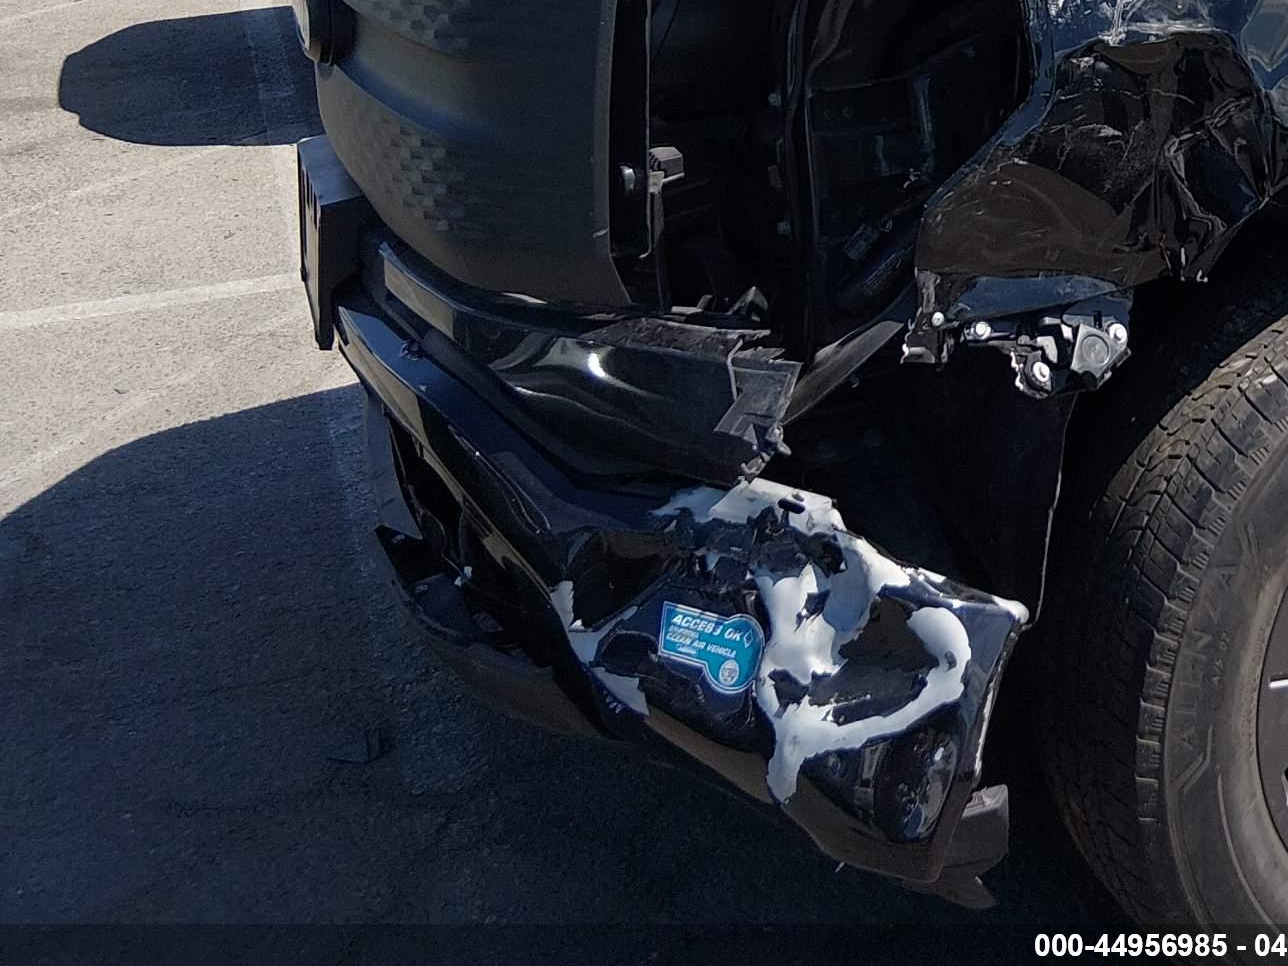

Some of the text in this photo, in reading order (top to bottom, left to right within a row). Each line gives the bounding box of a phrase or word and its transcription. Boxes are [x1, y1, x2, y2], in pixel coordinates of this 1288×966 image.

[666, 633, 692, 646] CLEAN
[692, 639, 706, 650] AIR
[724, 627, 743, 642] OK
